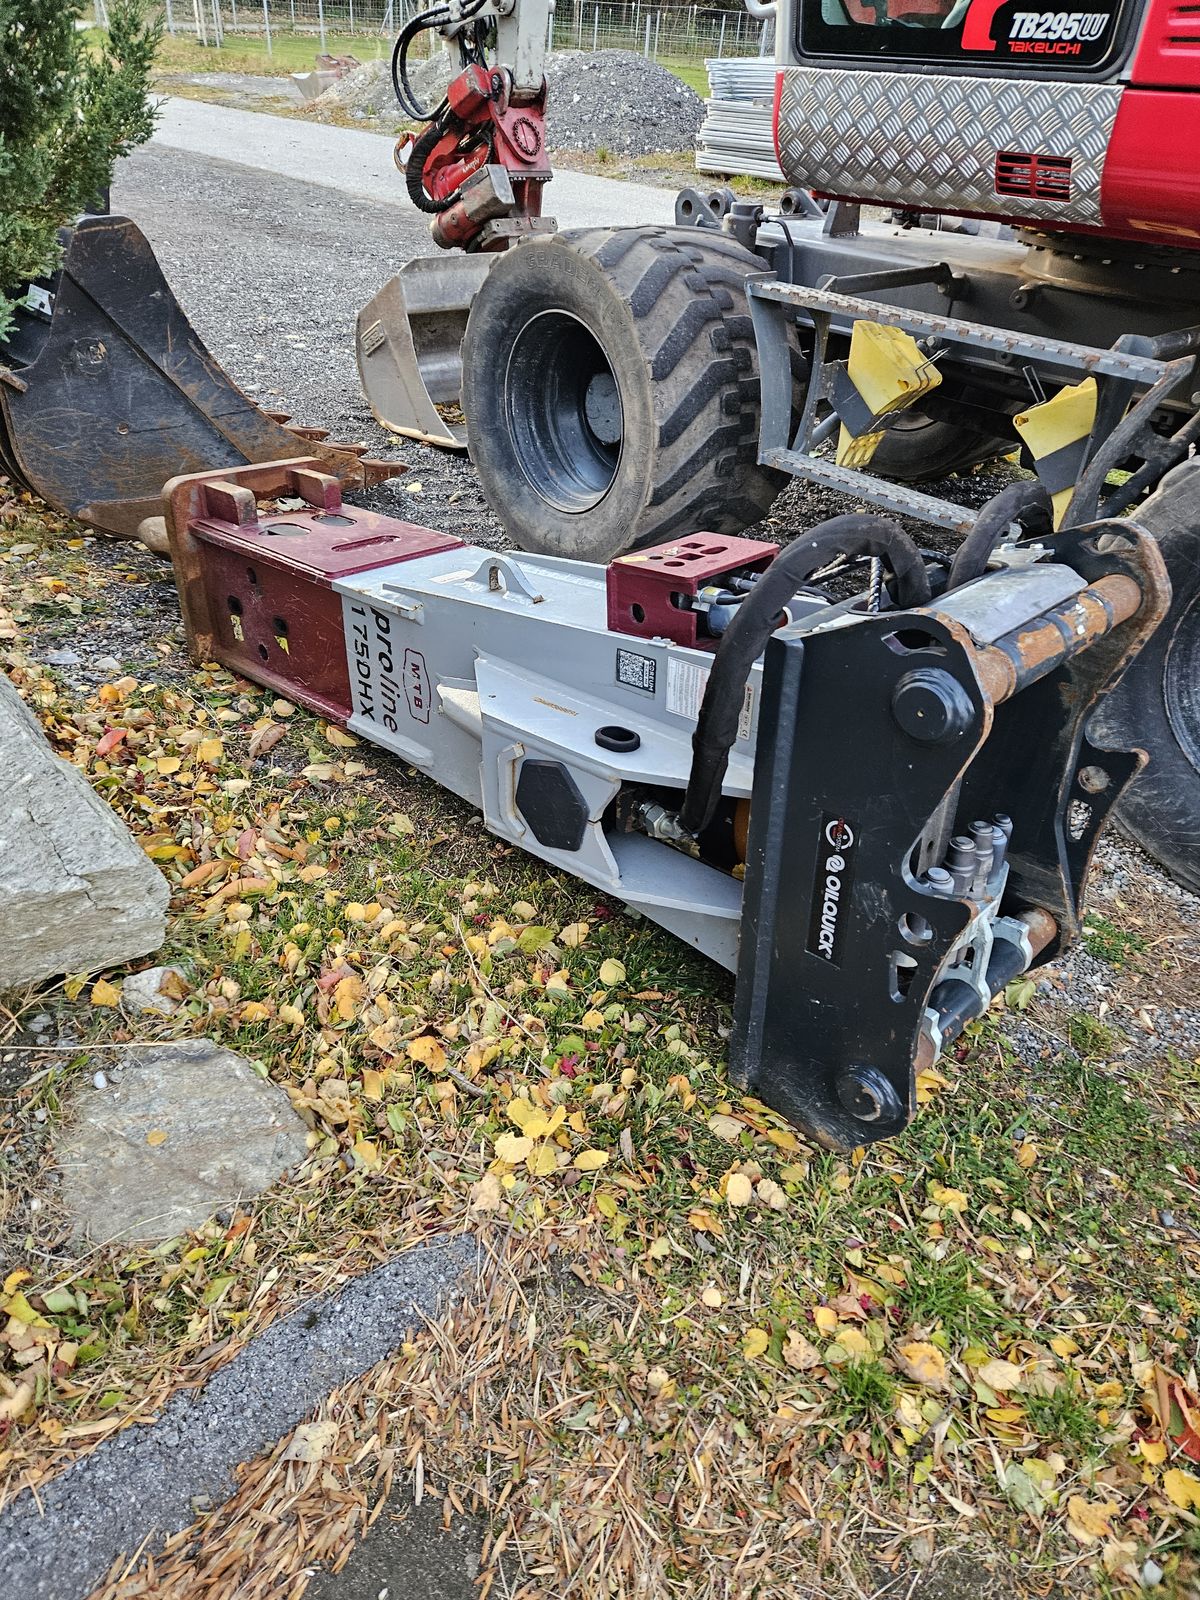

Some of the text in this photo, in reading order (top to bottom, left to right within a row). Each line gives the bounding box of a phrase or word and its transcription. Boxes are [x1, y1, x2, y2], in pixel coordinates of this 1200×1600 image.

[1009, 12, 1110, 41] TB295W
[371, 606, 400, 733] proline
[411, 663, 423, 709] MTB
[818, 875, 841, 956] OILQUICK
